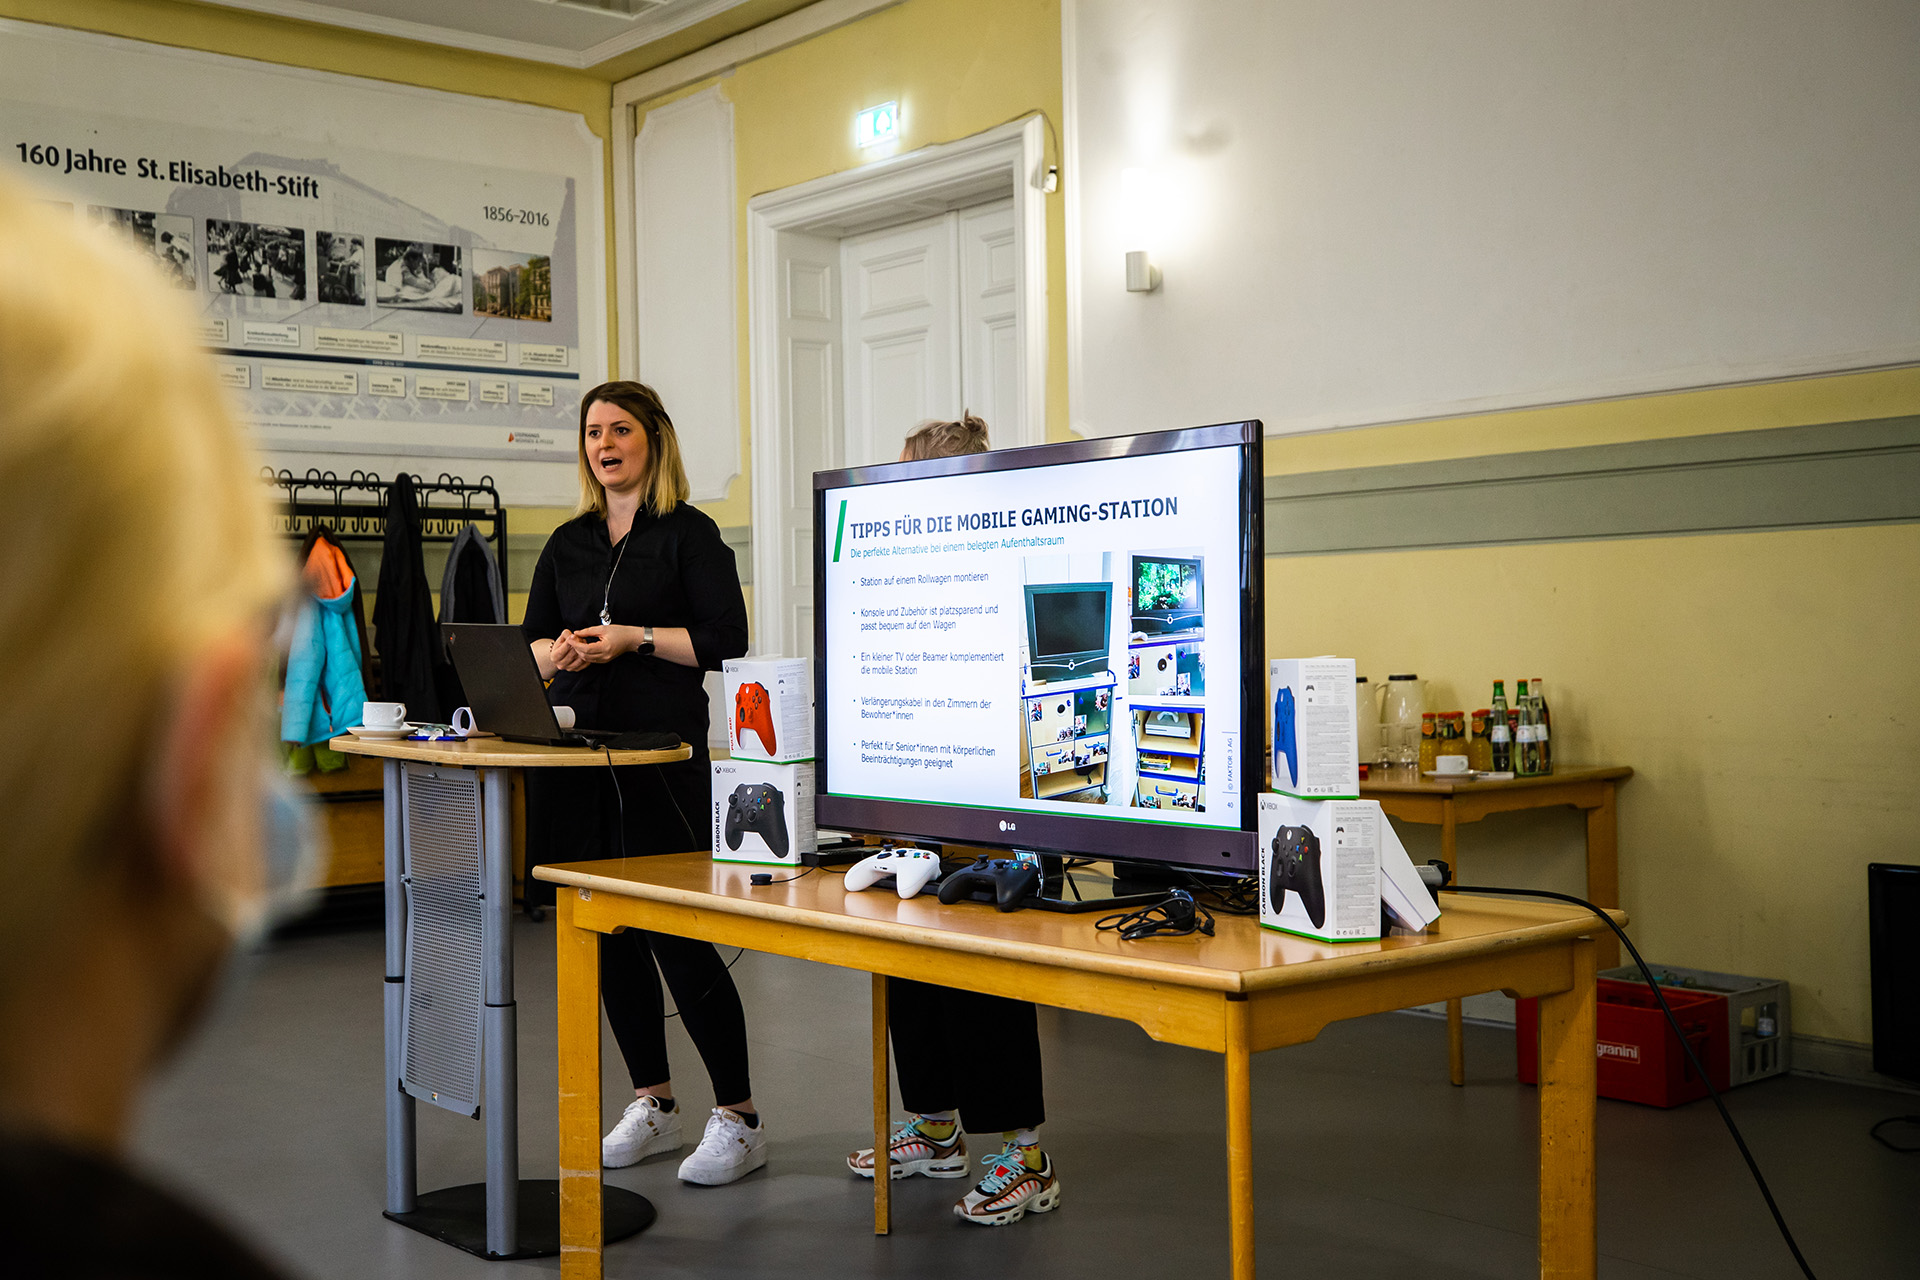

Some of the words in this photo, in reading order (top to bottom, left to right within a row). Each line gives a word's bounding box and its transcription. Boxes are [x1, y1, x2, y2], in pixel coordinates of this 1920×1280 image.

[16, 142, 60, 167] 160
[64, 148, 127, 175] Jahre
[137, 157, 165, 181] St.
[169, 160, 319, 199] Elisabeth-Stift
[850, 521, 891, 539] TIPPS
[895, 514, 922, 536] FÜR
[927, 515, 953, 534] DIE
[957, 510, 1017, 532] MOBILE
[1022, 496, 1178, 527] GAMING-STATION
[850, 548, 862, 558] Die
[863, 546, 891, 559] perfekte
[892, 543, 928, 555] Alternative
[930, 543, 941, 553] bei
[943, 542, 966, 552] einem
[967, 540, 999, 552] belegten
[1001, 535, 1065, 549] Aufenthaltsraum
[860, 577, 883, 587] Station
[884, 575, 895, 585] auf
[896, 575, 916, 585] einem
[918, 573, 952, 586] Rollwagen
[953, 572, 989, 583] montieren
[860, 607, 885, 617] Konsole
[886, 606, 899, 616] und
[900, 606, 928, 616] Zubehör
[930, 606, 938, 615] ist
[939, 605, 983, 618] platzsparend
[985, 604, 999, 614] und
[860, 622, 878, 632] passt
[879, 620, 905, 632] bequem
[906, 620, 918, 630] auf
[918, 619, 931, 630] den
[932, 620, 957, 631] Wagen
[860, 652, 871, 661] Ein
[872, 651, 893, 661] kleiner
[895, 651, 905, 661] TV
[905, 651, 921, 661] oder
[922, 651, 949, 661] Beamer
[950, 651, 1005, 663] komplementiert
[860, 665, 871, 674] die
[872, 665, 893, 675] mobile
[894, 665, 918, 675] Station
[861, 696, 923, 709] Verlängerungskabel
[924, 698, 931, 707] in
[932, 698, 946, 708] den
[947, 698, 979, 709] Zimmern
[980, 699, 992, 709] der
[861, 739, 884, 750] Perfekt
[884, 740, 895, 751] für
[939, 743, 952, 754] mit
[952, 744, 996, 757] körperlichen
[1226, 737, 1233, 748] AG
[861, 753, 923, 768] Beeinträchtigungen
[923, 758, 953, 769] geeignet
[1226, 755, 1234, 782] FAKTOR
[1596, 1043, 1638, 1059] granini
